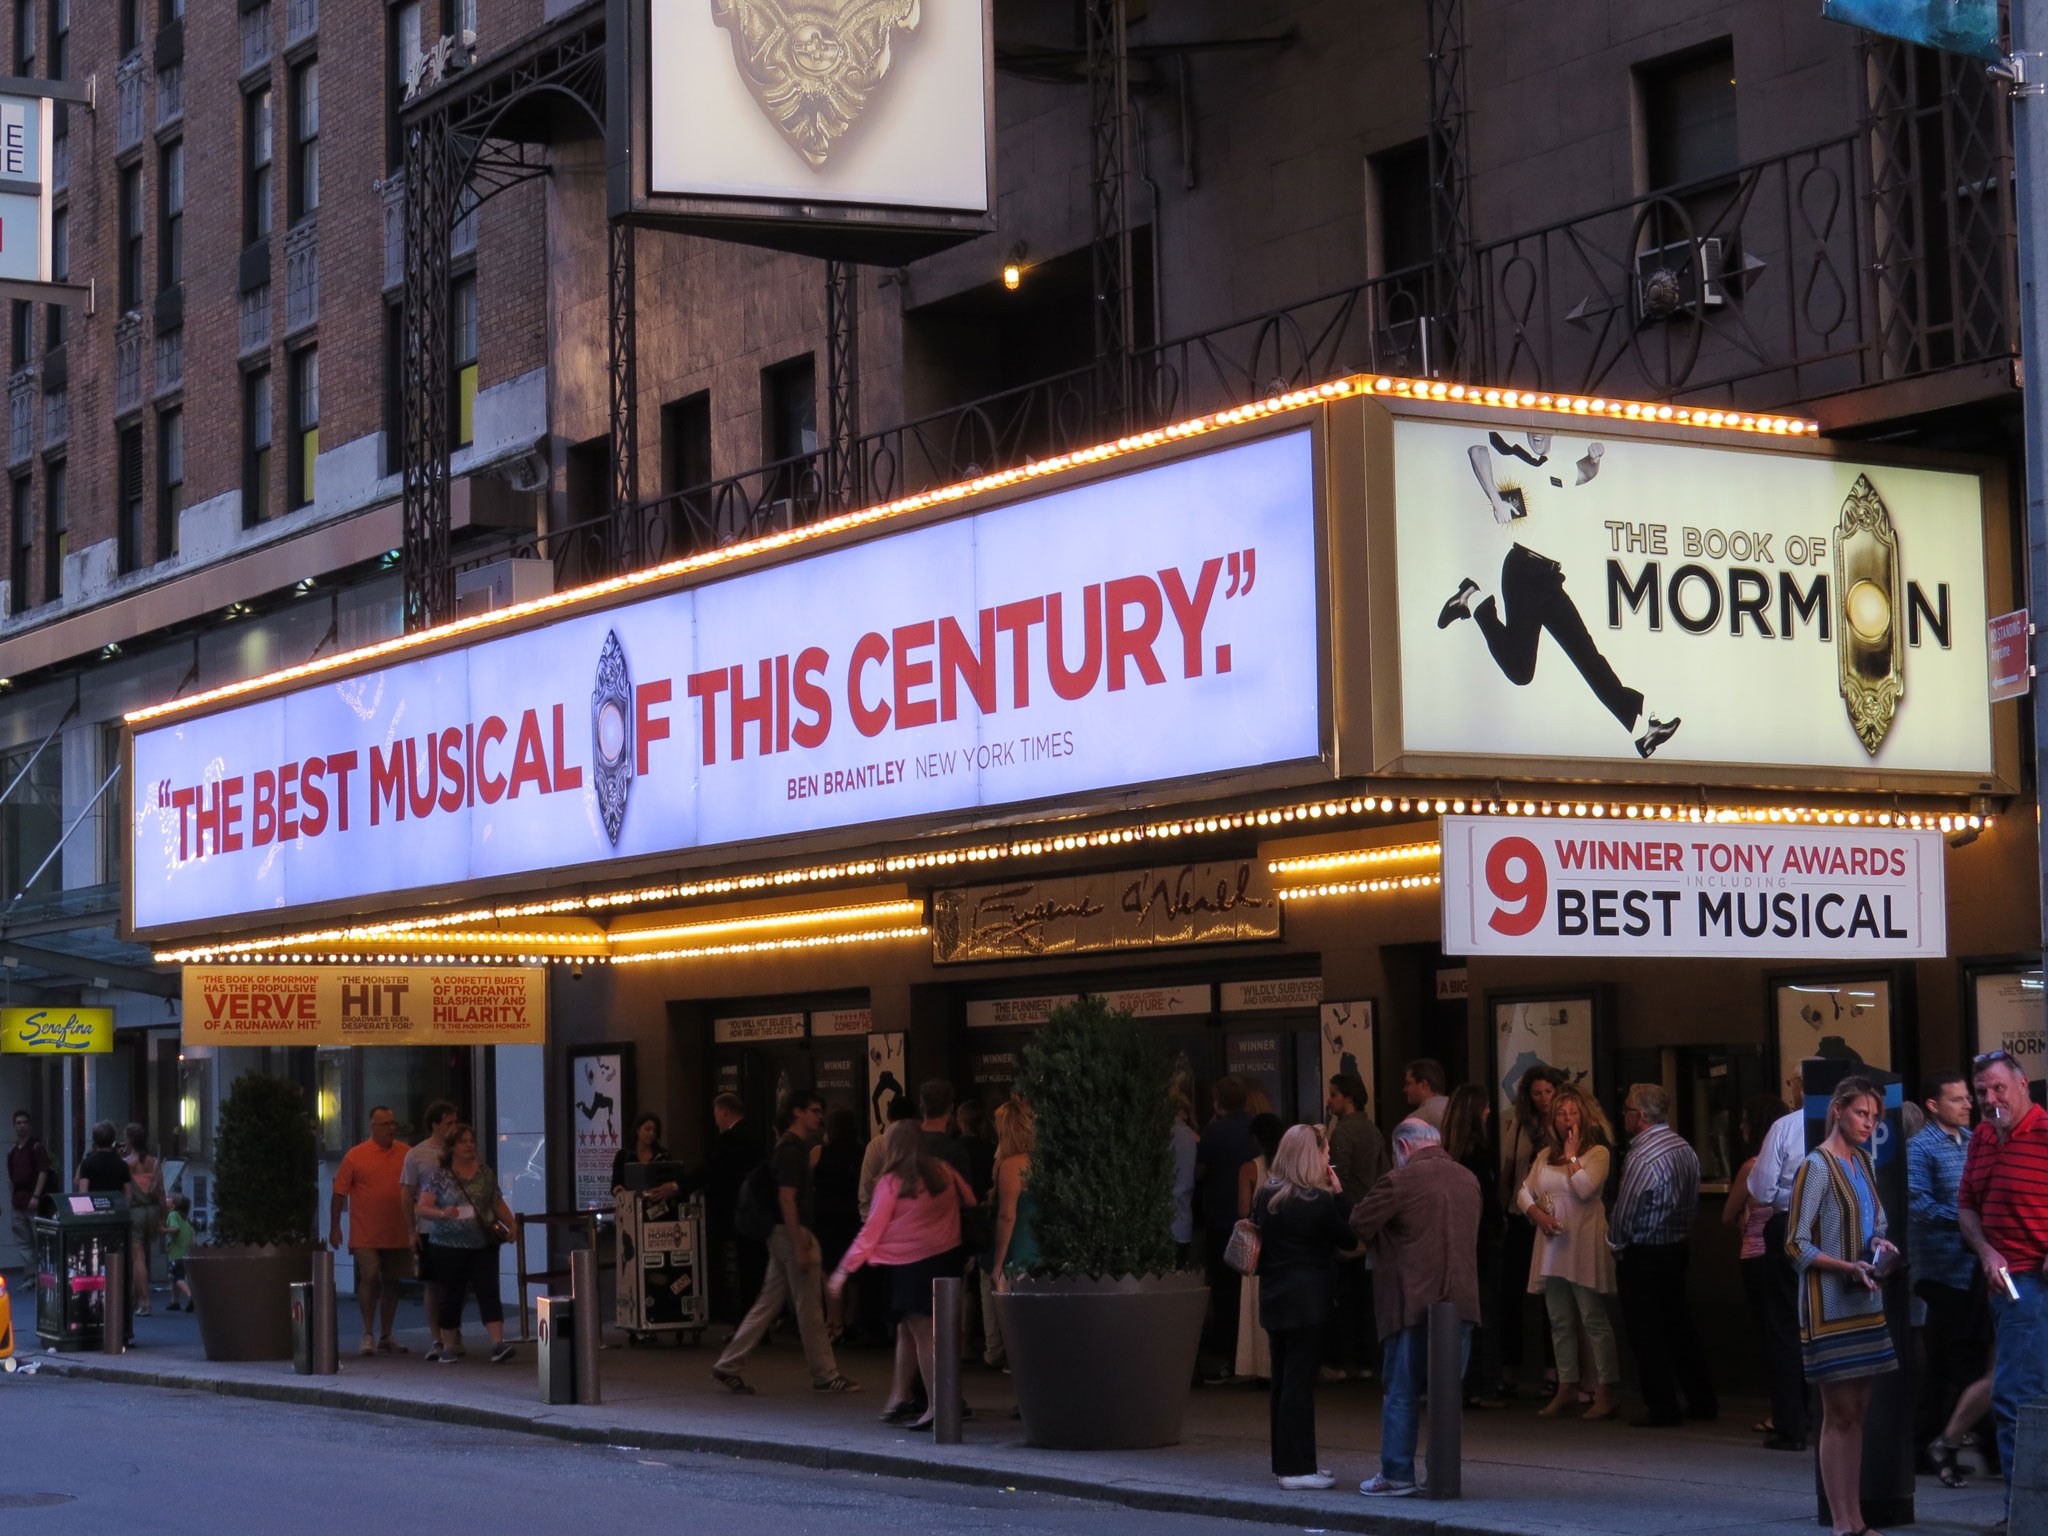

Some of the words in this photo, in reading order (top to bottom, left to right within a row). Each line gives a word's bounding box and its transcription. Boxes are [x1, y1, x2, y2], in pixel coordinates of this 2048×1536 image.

[1604, 520, 1668, 554] THE
[1682, 526, 1774, 563] BOOK
[1785, 535, 1826, 565] OF
[1998, 620, 2021, 641] STANDING
[158, 775, 243, 861] "THE
[252, 750, 358, 847] BEST
[369, 703, 583, 826] MUSICAL
[688, 646, 832, 766] THIS
[787, 772, 819, 800] BEN
[824, 759, 906, 794] BRANTLEY
[916, 748, 957, 779] NEW
[962, 739, 1015, 771] YORK
[1020, 730, 1075, 761] TIMES
[1555, 839, 1684, 872] WINNER
[1691, 843, 1774, 874] TONY
[1485, 836, 1548, 936] 9
[1686, 876, 1789, 889] INCLUDING
[1556, 889, 1681, 937] BEST
[1700, 892, 1908, 939] MUSICAL
[226, 975, 254, 984] BOOK
[257, 975, 270, 984] OF
[363, 976, 409, 984] MONSTER
[443, 976, 492, 985] CONFETTI
[494, 976, 526, 985] BURST
[204, 984, 226, 993] HAS
[229, 984, 250, 993] THE
[251, 984, 317, 993] PROPULSIVE
[433, 985, 451, 996] OF
[454, 985, 526, 997] PROFANITY,
[204, 994, 317, 1019] VERVE
[342, 984, 409, 1016] HIT
[433, 997, 499, 1006] BLASPHEMY
[502, 997, 526, 1006] AND
[1012, 999, 1052, 1013] FUNNIEST
[433, 1006, 527, 1022] HILARITY.
[19, 1012, 94, 1047] Serafina
[204, 1020, 220, 1030] OF
[223, 1020, 232, 1030] A
[235, 1020, 295, 1030] RUNAWAY
[1238, 1039, 1275, 1052] WINNER
[983, 1053, 1014, 1064] WINNER
[1229, 1063, 1245, 1072] BEST
[1247, 1062, 1275, 1072] MUSICAL
